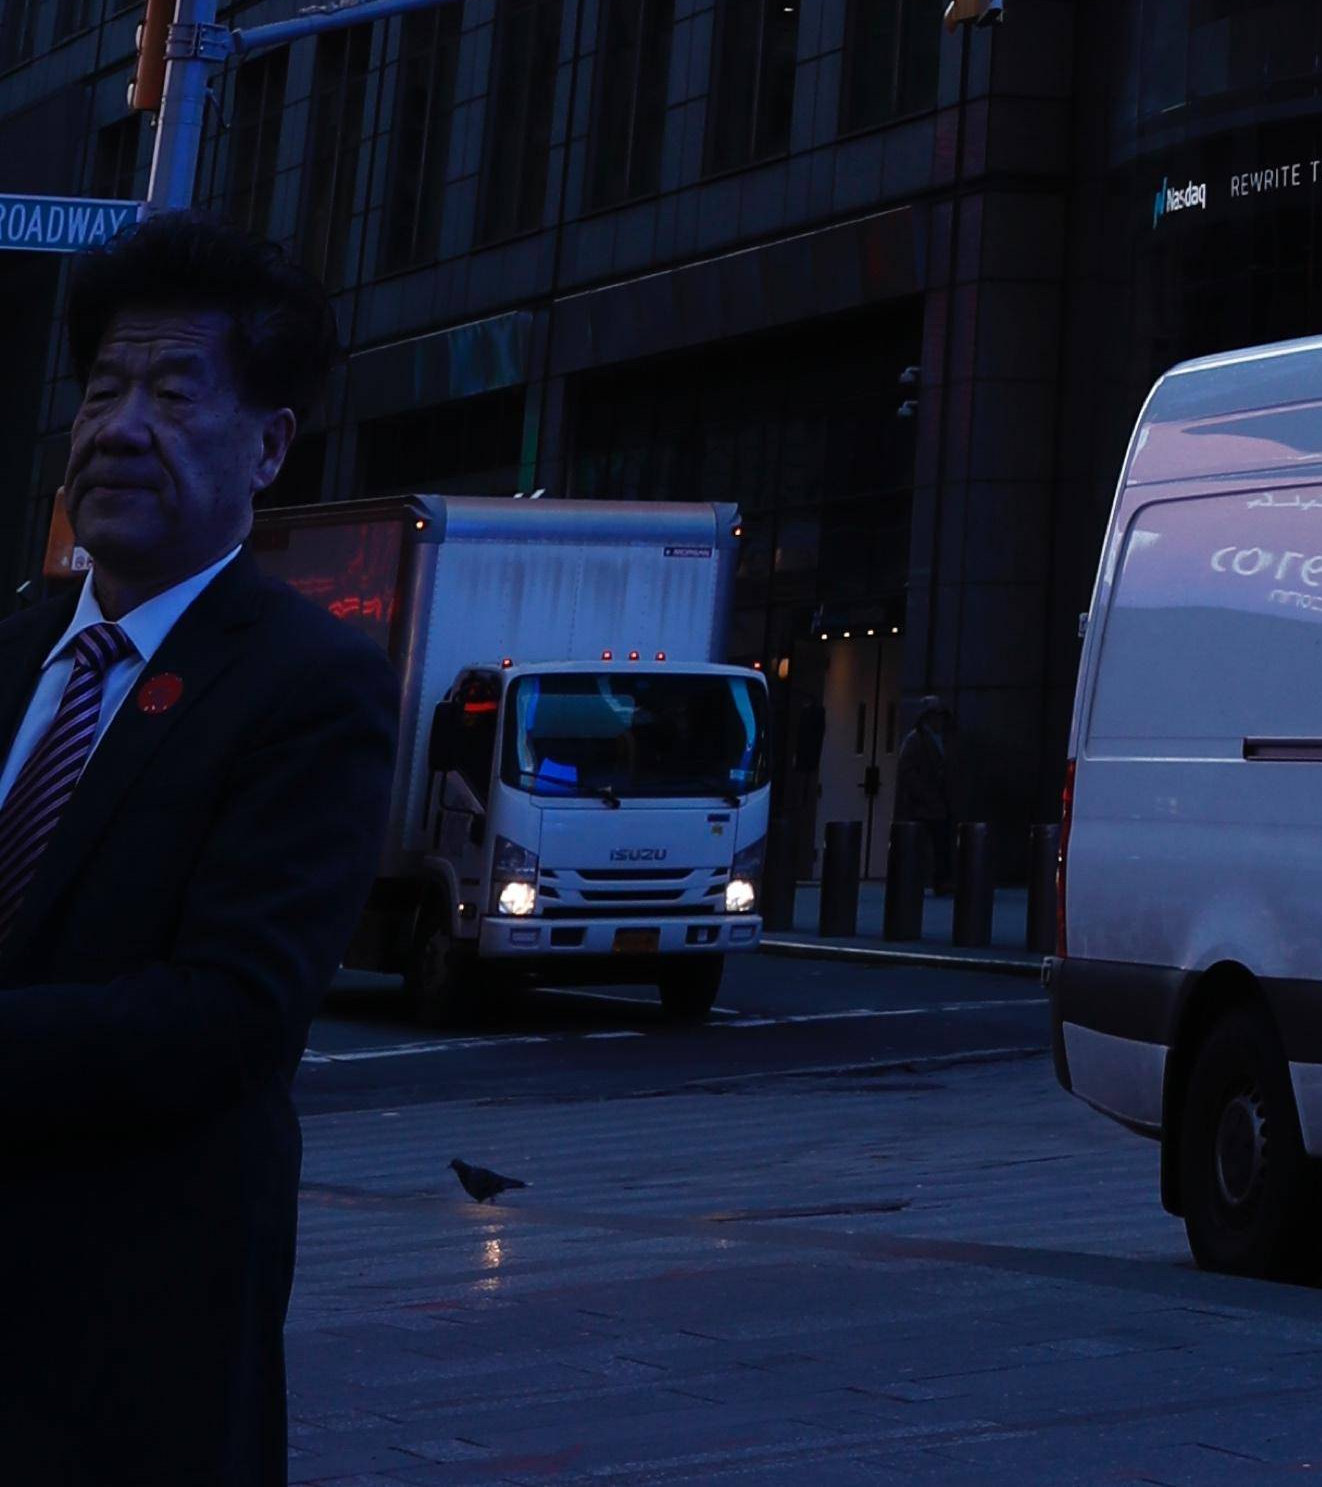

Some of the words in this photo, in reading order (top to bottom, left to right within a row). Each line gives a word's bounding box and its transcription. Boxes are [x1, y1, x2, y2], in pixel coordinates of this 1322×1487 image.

[1166, 180, 1208, 213] Nasdaq
[1230, 163, 1302, 197] REWRITE
[610, 848, 667, 861] ISUZU
